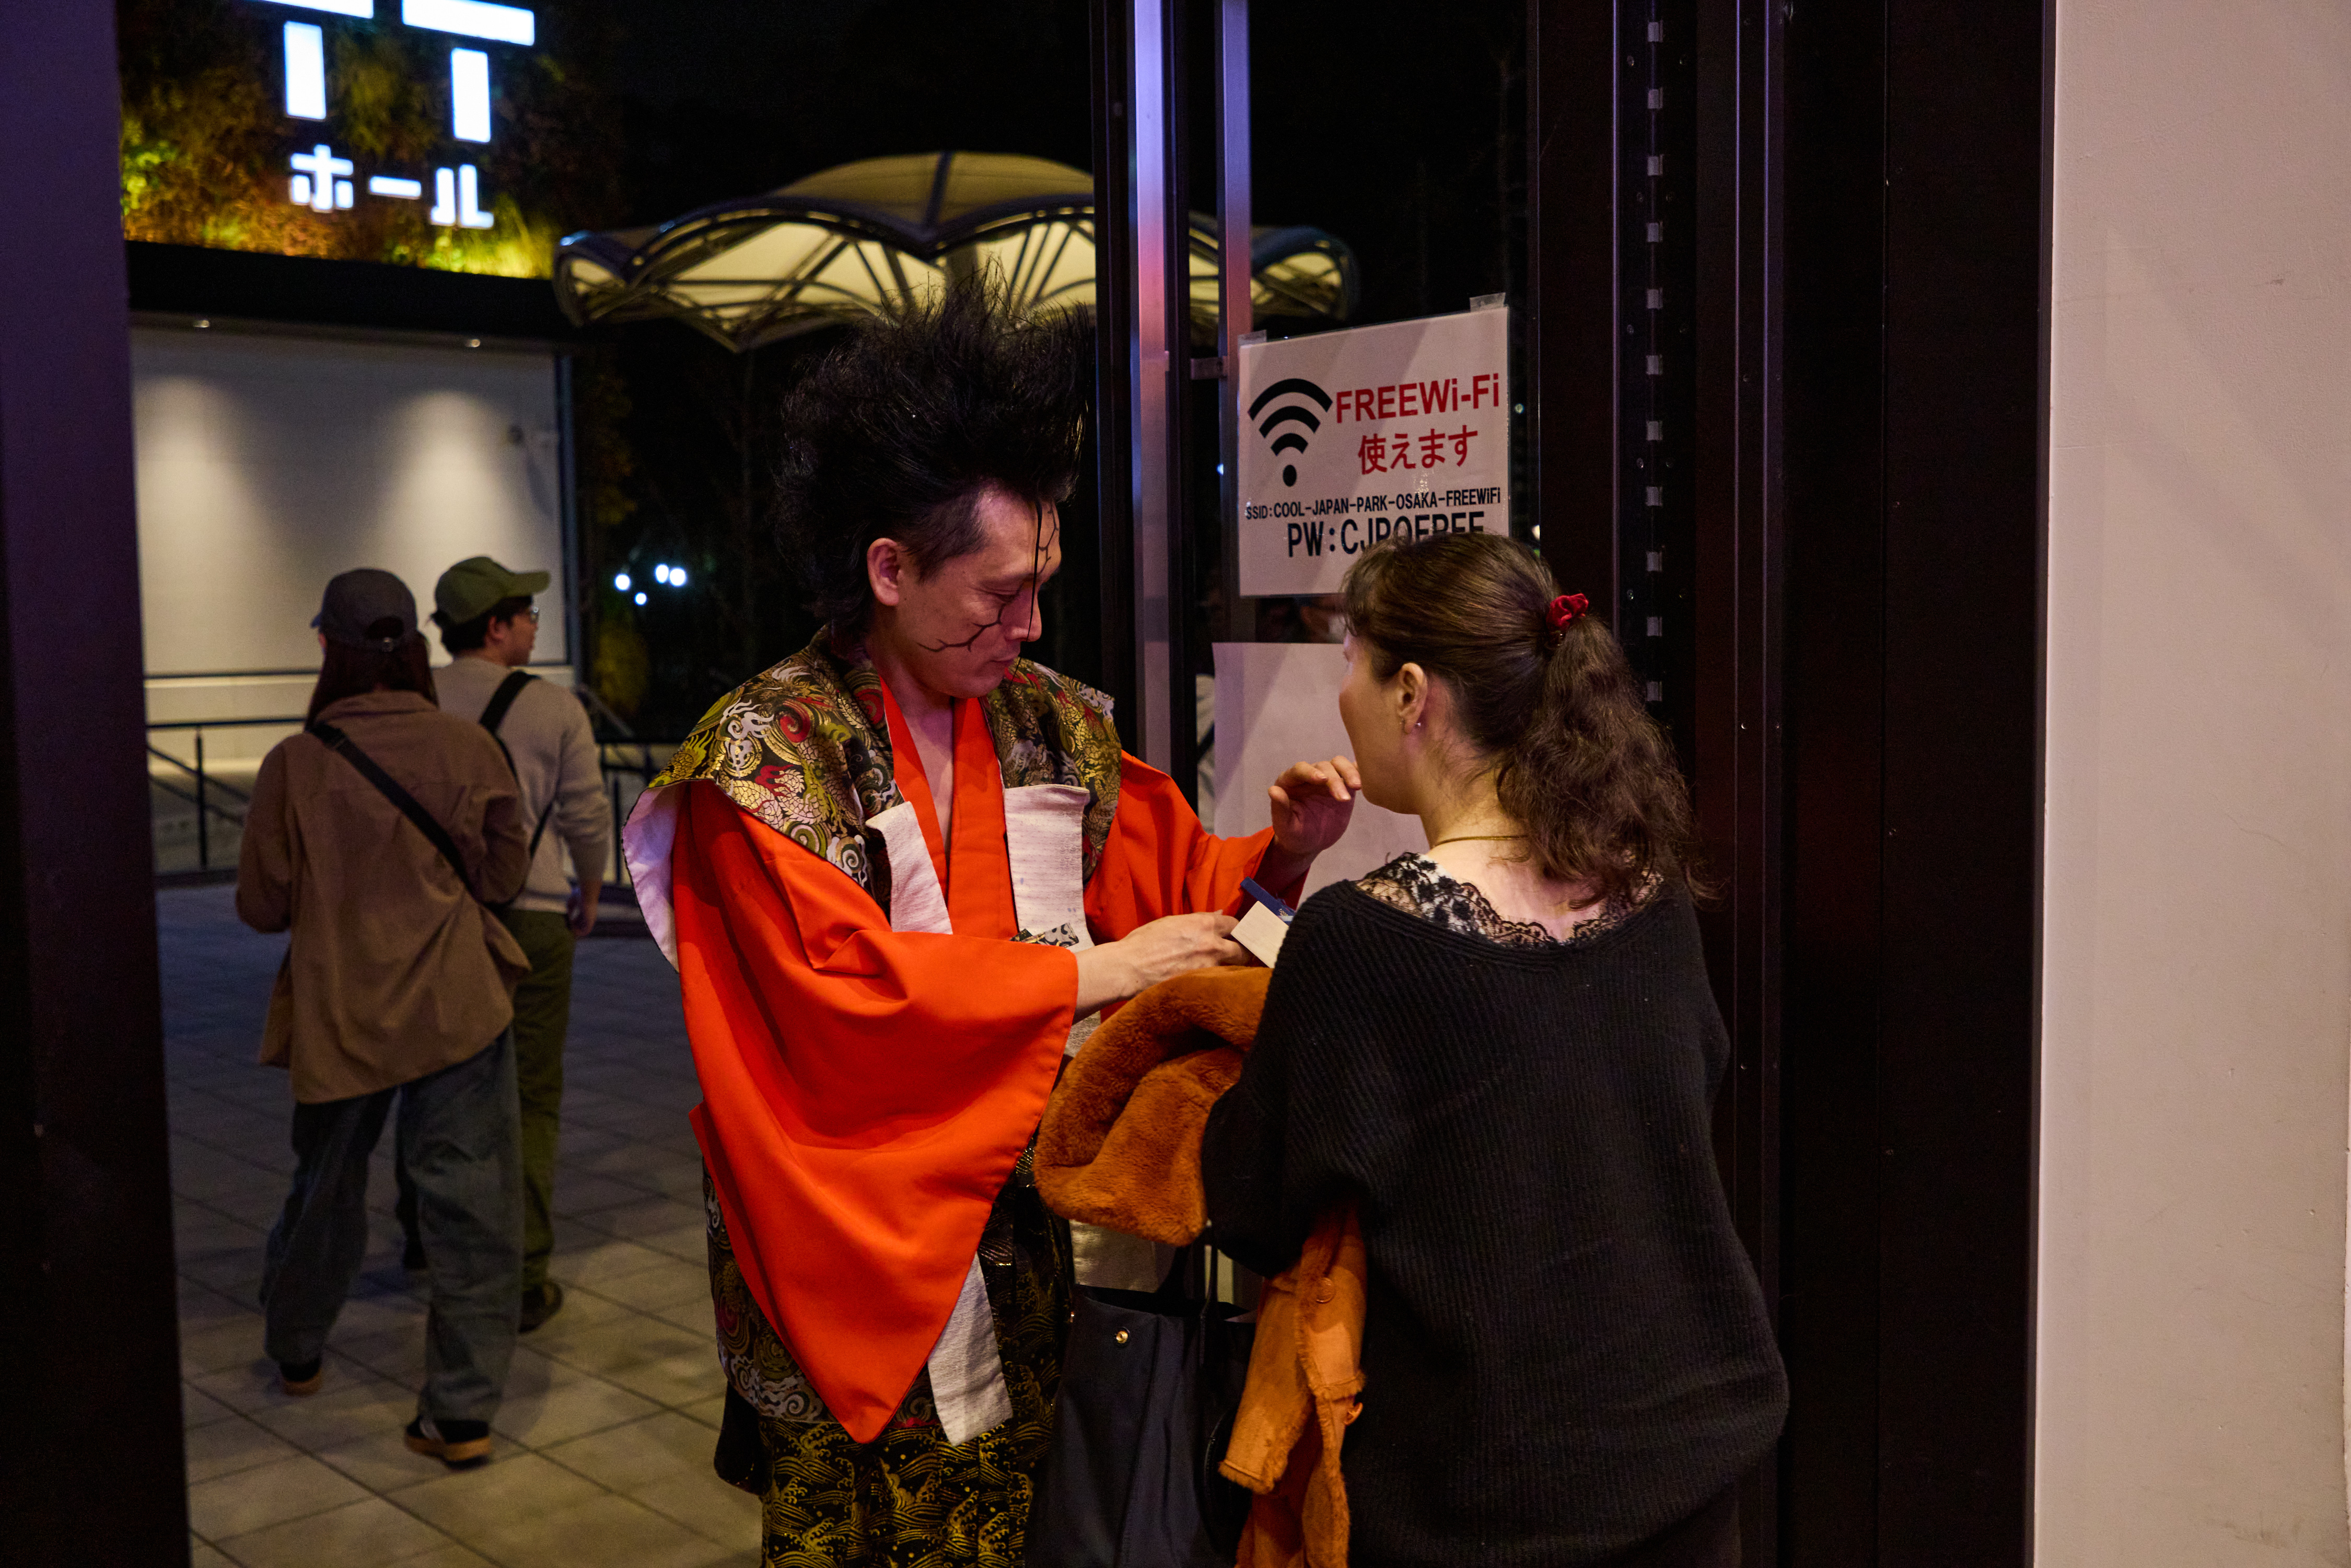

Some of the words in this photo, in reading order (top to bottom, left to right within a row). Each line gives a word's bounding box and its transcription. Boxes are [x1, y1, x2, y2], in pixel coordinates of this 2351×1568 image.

[290, 144, 495, 229] ホール
[1358, 424, 1478, 475] 使えます
